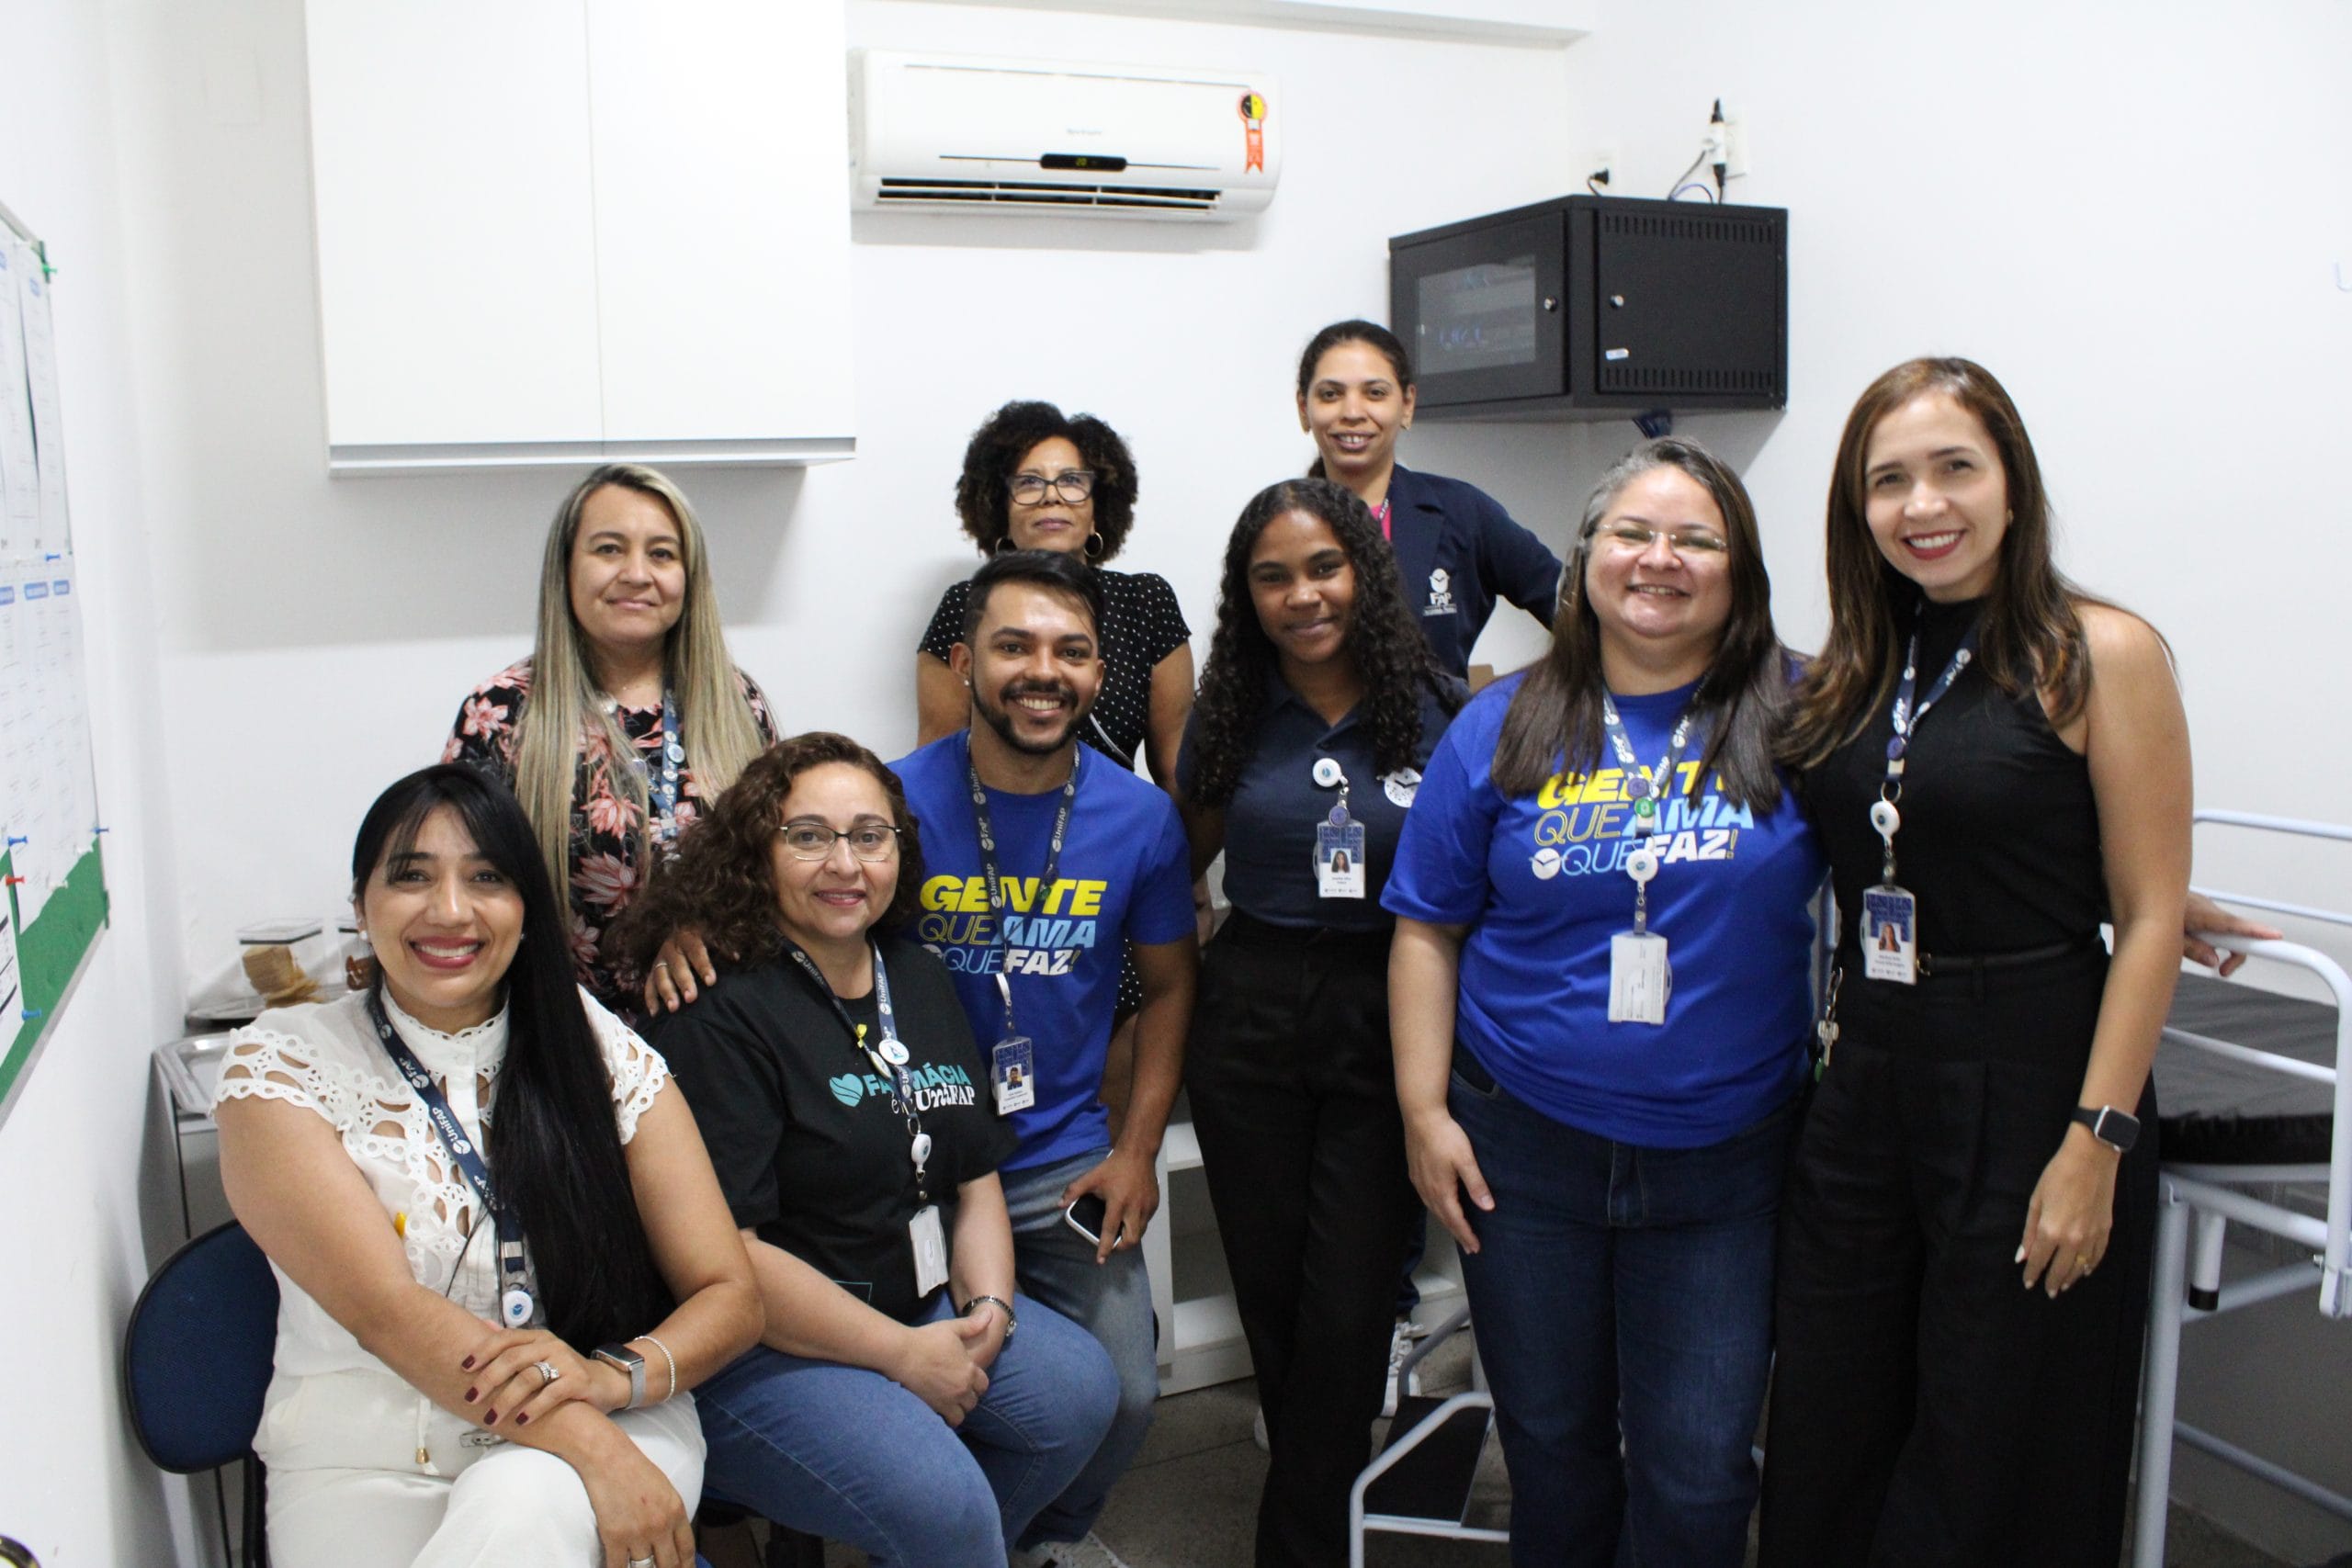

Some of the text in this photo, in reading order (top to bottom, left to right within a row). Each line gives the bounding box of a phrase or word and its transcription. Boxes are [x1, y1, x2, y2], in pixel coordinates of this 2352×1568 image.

[978, 817, 989, 838] FAP
[1055, 807, 1066, 840] UniFAP
[1534, 804, 1629, 846] QUE
[1562, 839, 1644, 876] QUE
[920, 875, 1107, 915] GENTE
[987, 863, 997, 896] UniFAP
[919, 913, 1096, 948] QUE AMA
[943, 947, 1080, 976] QUE FAZ!
[878, 973, 888, 1002] UniFAP
[914, 1082, 975, 1111] UniFAP
[432, 1107, 458, 1143] UniFAP
